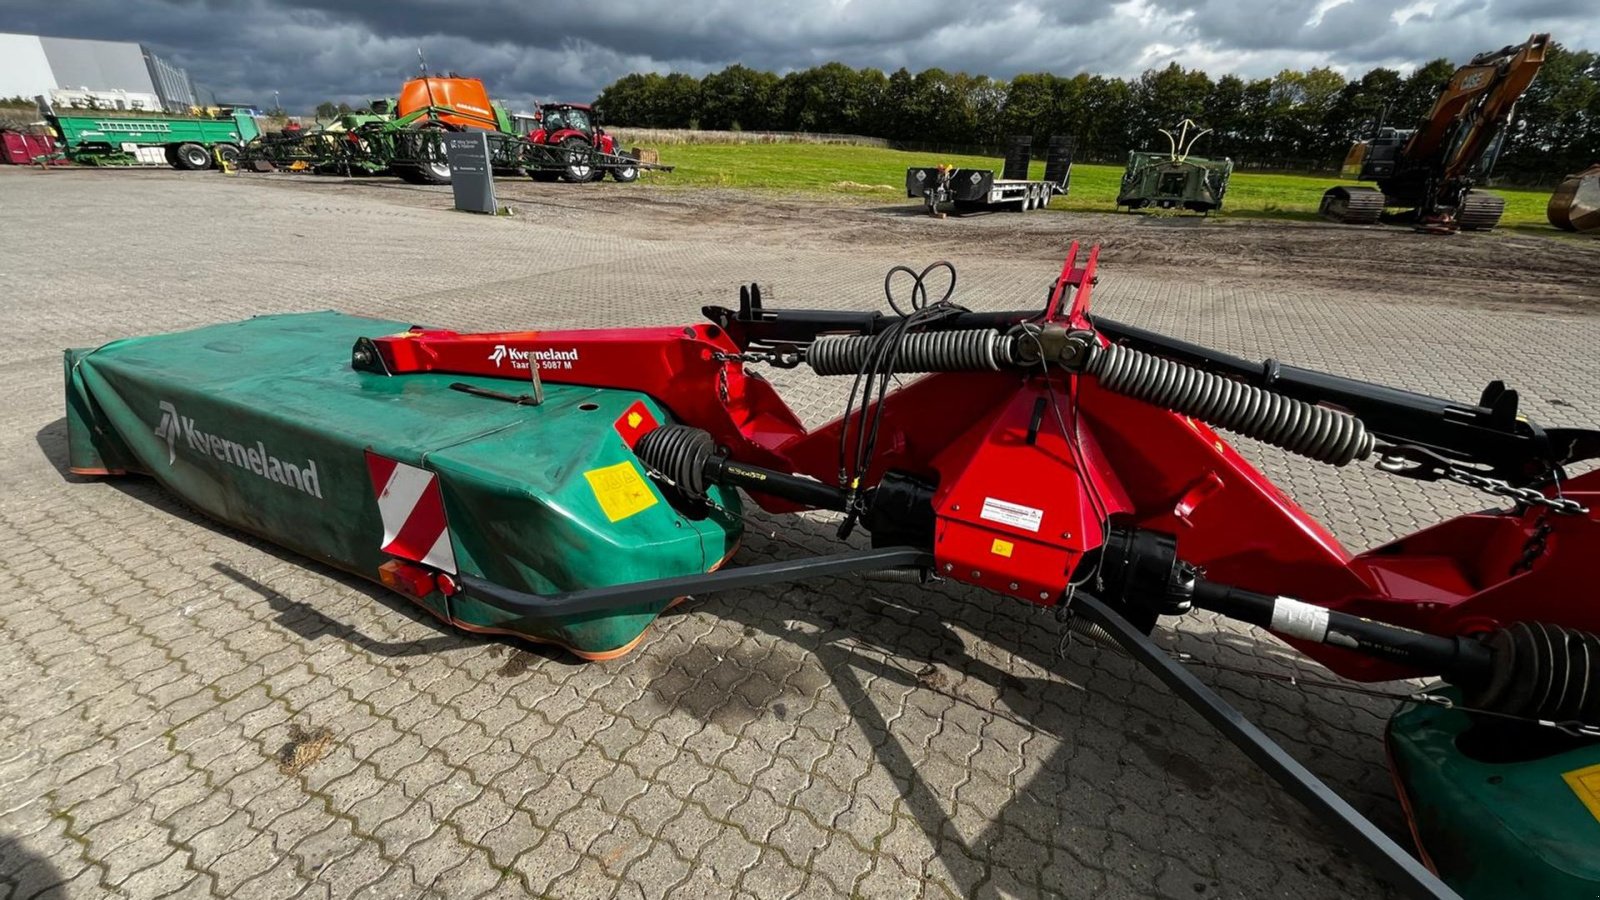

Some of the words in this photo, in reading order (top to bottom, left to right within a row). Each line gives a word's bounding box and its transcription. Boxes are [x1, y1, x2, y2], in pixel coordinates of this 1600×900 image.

[508, 348, 578, 360] Kveneland
[542, 361, 561, 369] 5087
[564, 361, 572, 369] M
[180, 415, 323, 500] Kverneland
